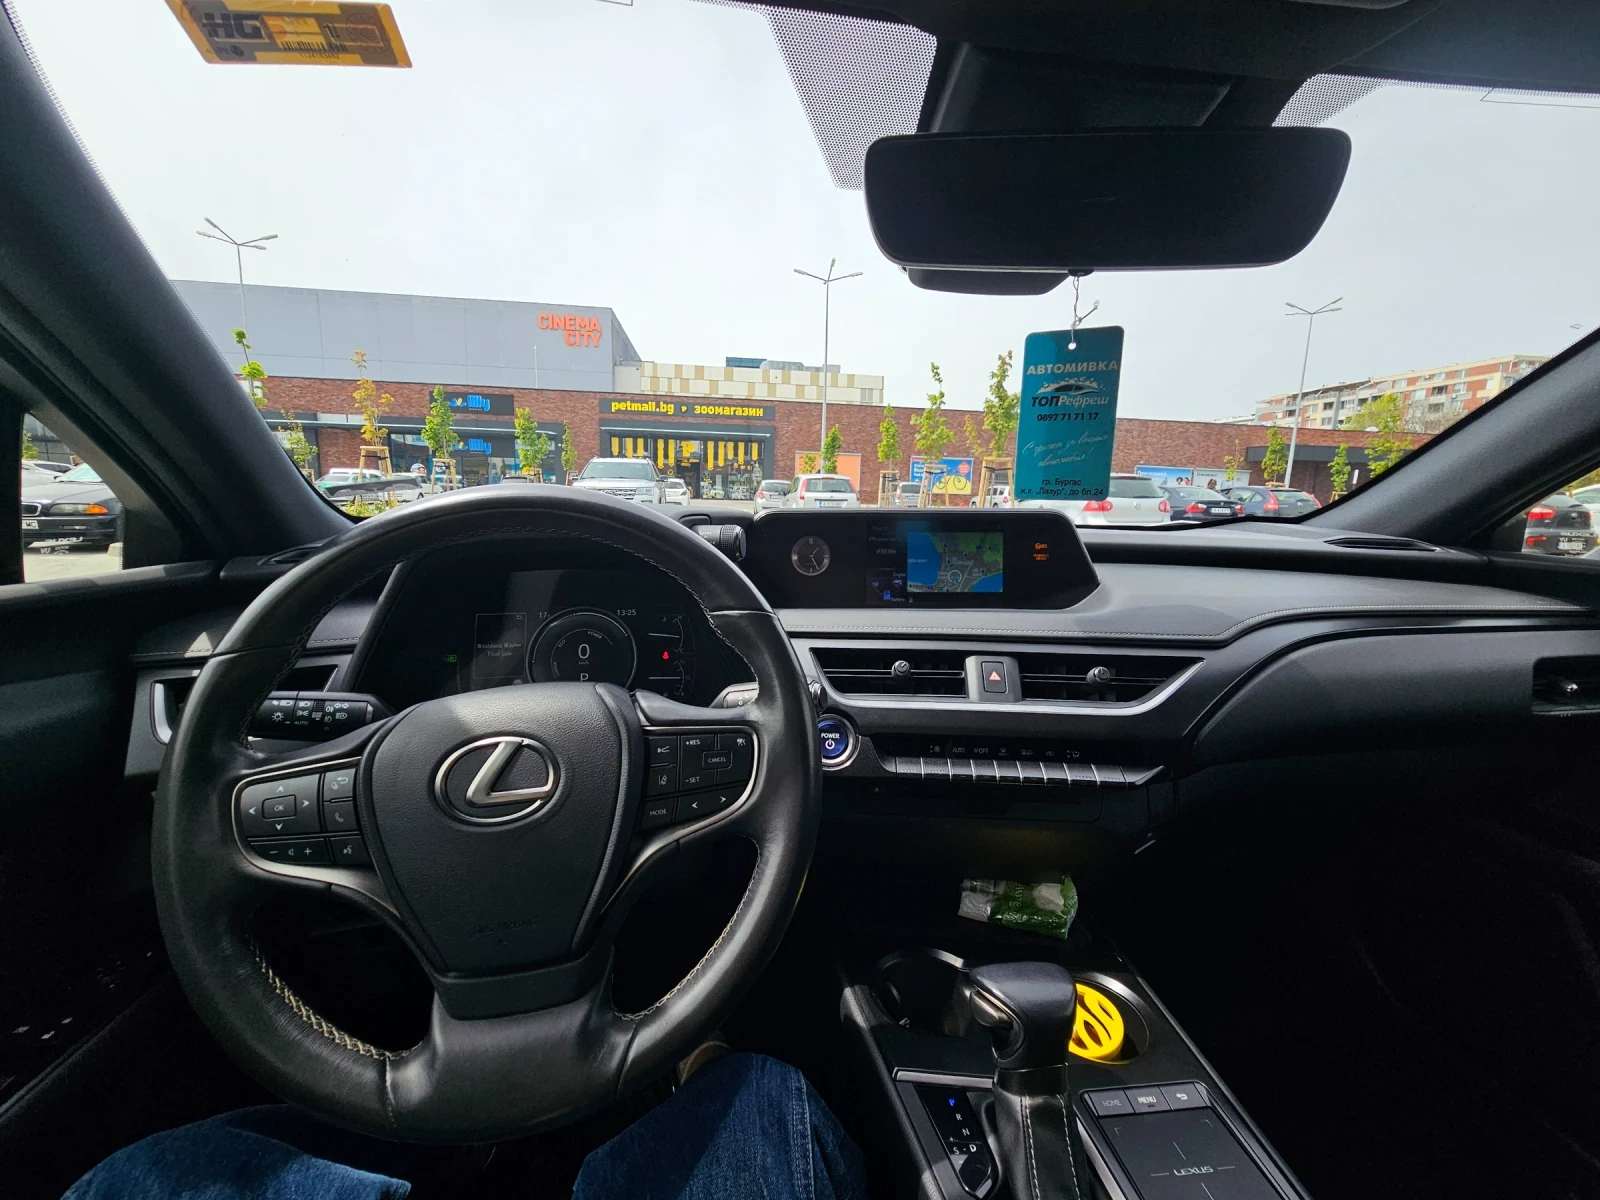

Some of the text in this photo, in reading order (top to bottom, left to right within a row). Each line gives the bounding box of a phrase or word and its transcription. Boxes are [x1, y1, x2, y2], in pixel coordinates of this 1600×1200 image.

[537, 312, 602, 332] CINEMA
[564, 331, 602, 348] CITY
[1026, 360, 1119, 375] АВТОМИВКА
[611, 400, 675, 414] petmall.bg
[694, 405, 764, 417] зоомагазин
[1037, 411, 1099, 422] 0897 71 71 17
[1055, 478, 1082, 488] Бургас
[587, 630, 603, 640] POWER
[558, 639, 566, 648] ECO
[578, 643, 590, 659] 0
[580, 673, 589, 682] P
[649, 808, 667, 816] MODE
[948, 1099, 955, 1107] P
[1102, 1099, 1121, 1107] HOME
[1137, 1096, 1157, 1104] MENU
[955, 1113, 962, 1121] R
[962, 1127, 970, 1136] N
[969, 1144, 977, 1153] D
[1173, 1165, 1213, 1176] LEXUS
